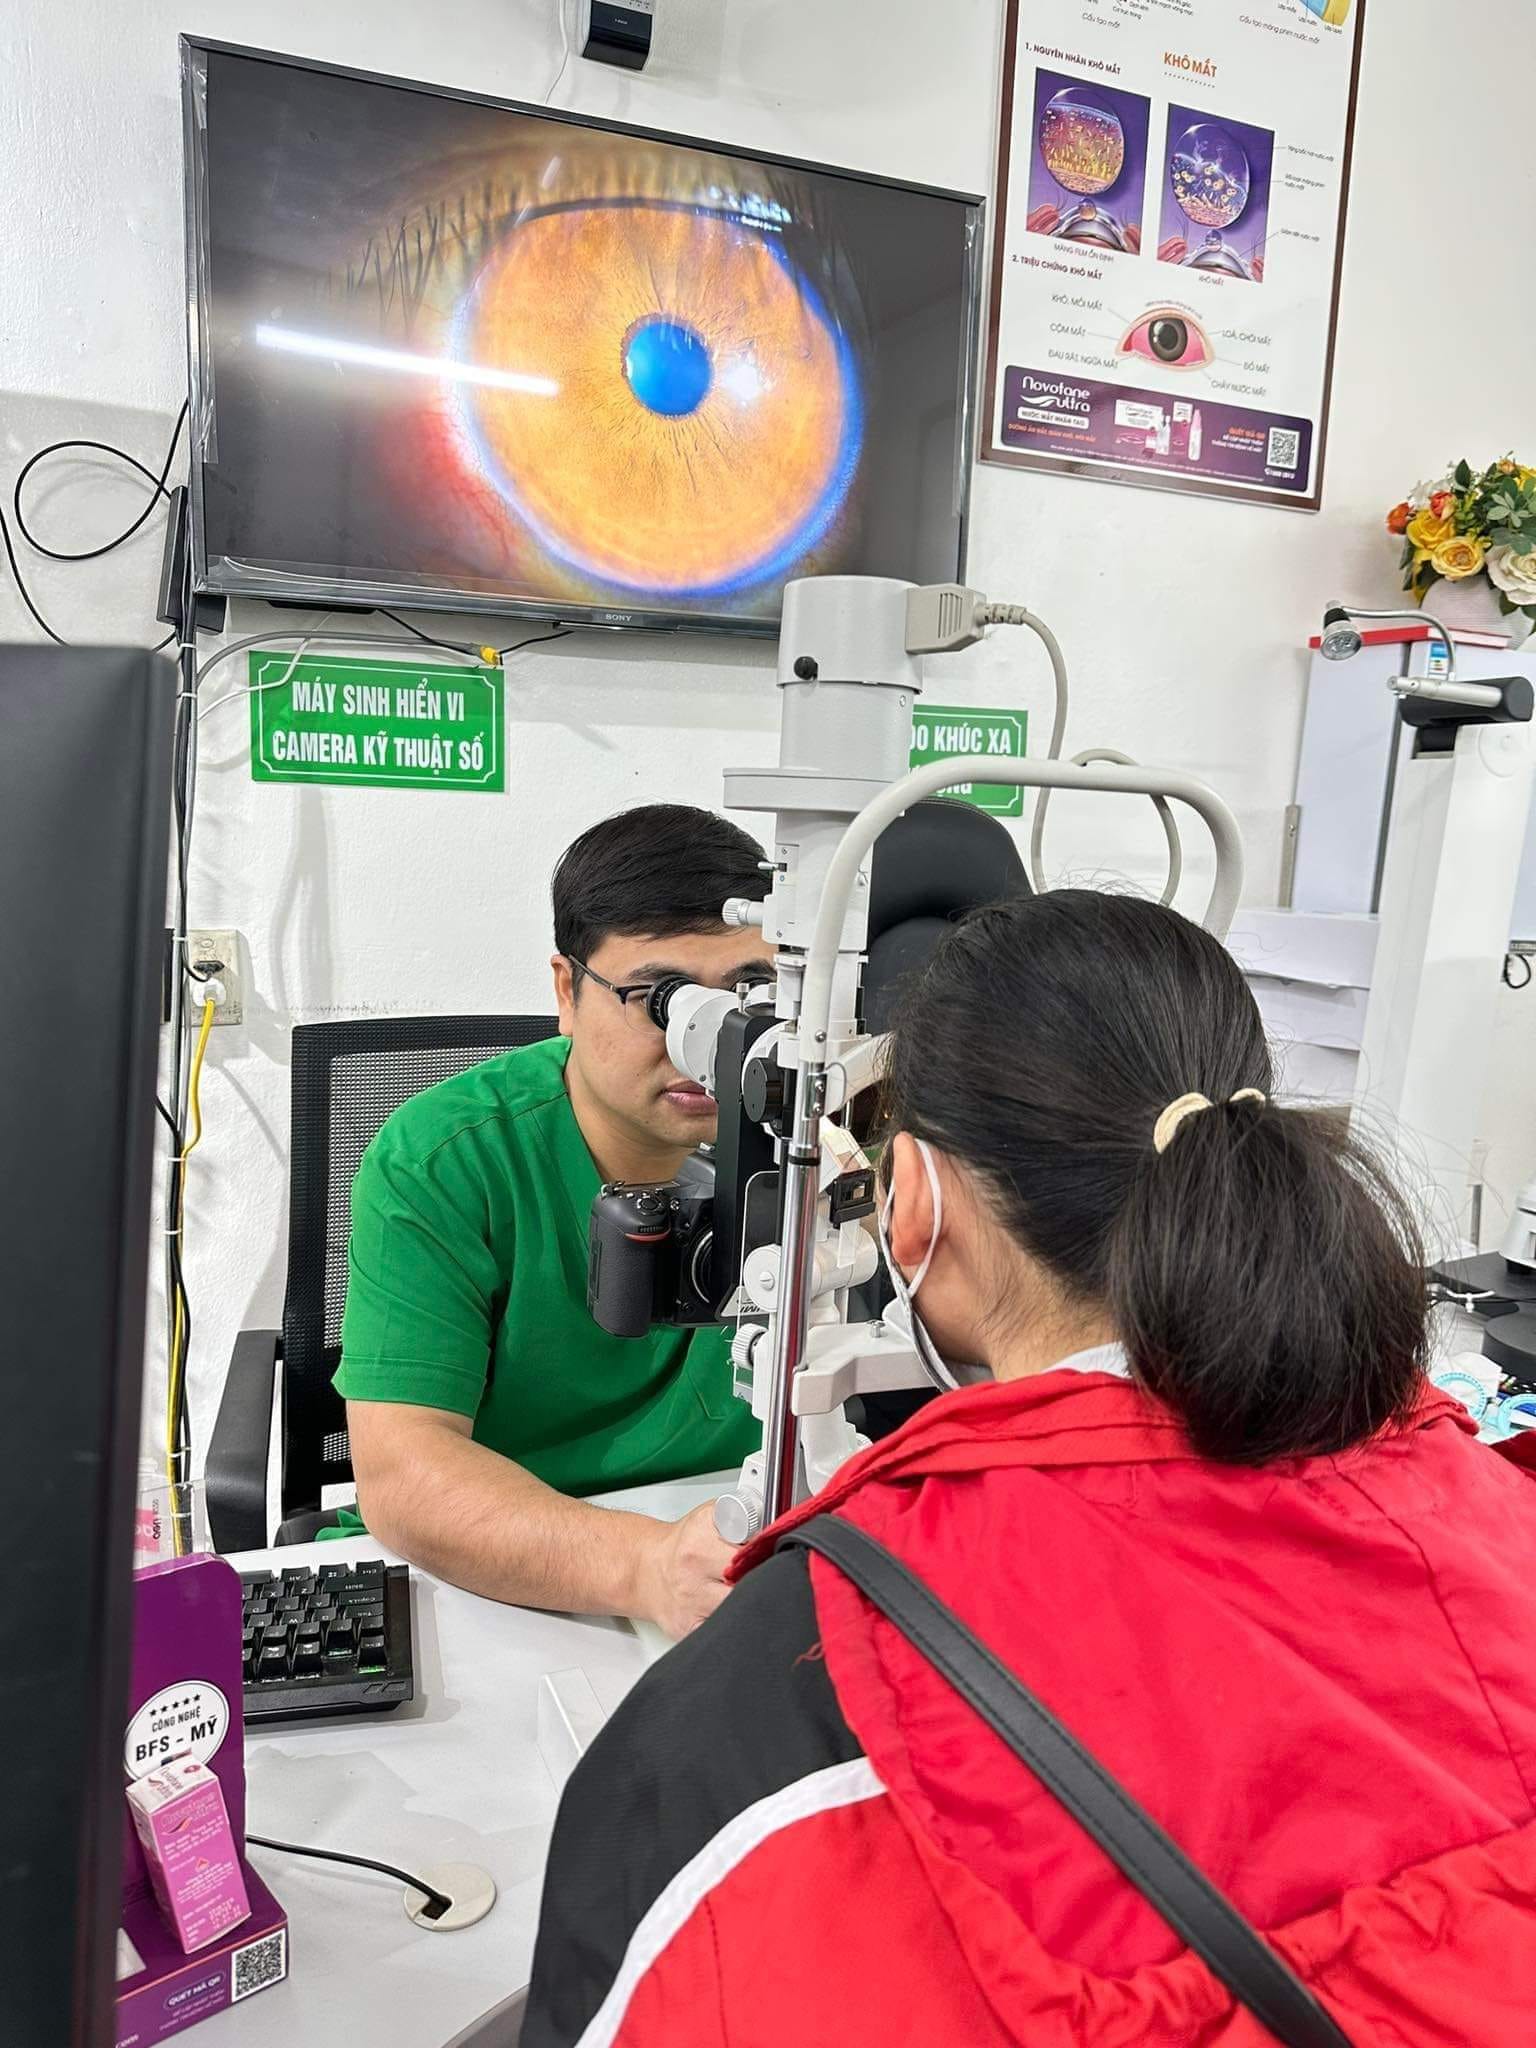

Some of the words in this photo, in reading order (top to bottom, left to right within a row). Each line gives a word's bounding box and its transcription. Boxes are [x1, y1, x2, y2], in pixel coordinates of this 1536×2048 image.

[1033, 44, 1064, 60] NGUYÊN
[1065, 52, 1087, 66] NHÂN
[1088, 58, 1104, 71] KHÔ
[1106, 62, 1121, 75] MẮT
[1163, 52, 1190, 70] KHÔ
[1192, 58, 1218, 78] MẮT
[1021, 256, 1040, 268] TRIỆU
[1041, 259, 1068, 273] CHỨNG
[1070, 266, 1086, 277] KHÔ
[1087, 269, 1103, 280] MẮT
[605, 613, 632, 622] SONY
[292, 676, 337, 713] MÁY
[343, 682, 390, 717] SINH
[396, 677, 441, 721] HIỂN
[447, 691, 465, 722] VI
[272, 729, 358, 765] CAMERA
[363, 730, 389, 766] KỸ
[393, 733, 454, 775] THUẬT
[458, 731, 485, 771] SỐ
[934, 722, 982, 753] KHÚC
[152, 1715, 175, 1733] CÔNG
[177, 1705, 201, 1723] NGHỆ
[135, 1735, 170, 1762] BFS
[190, 1714, 218, 1743] MỸ
